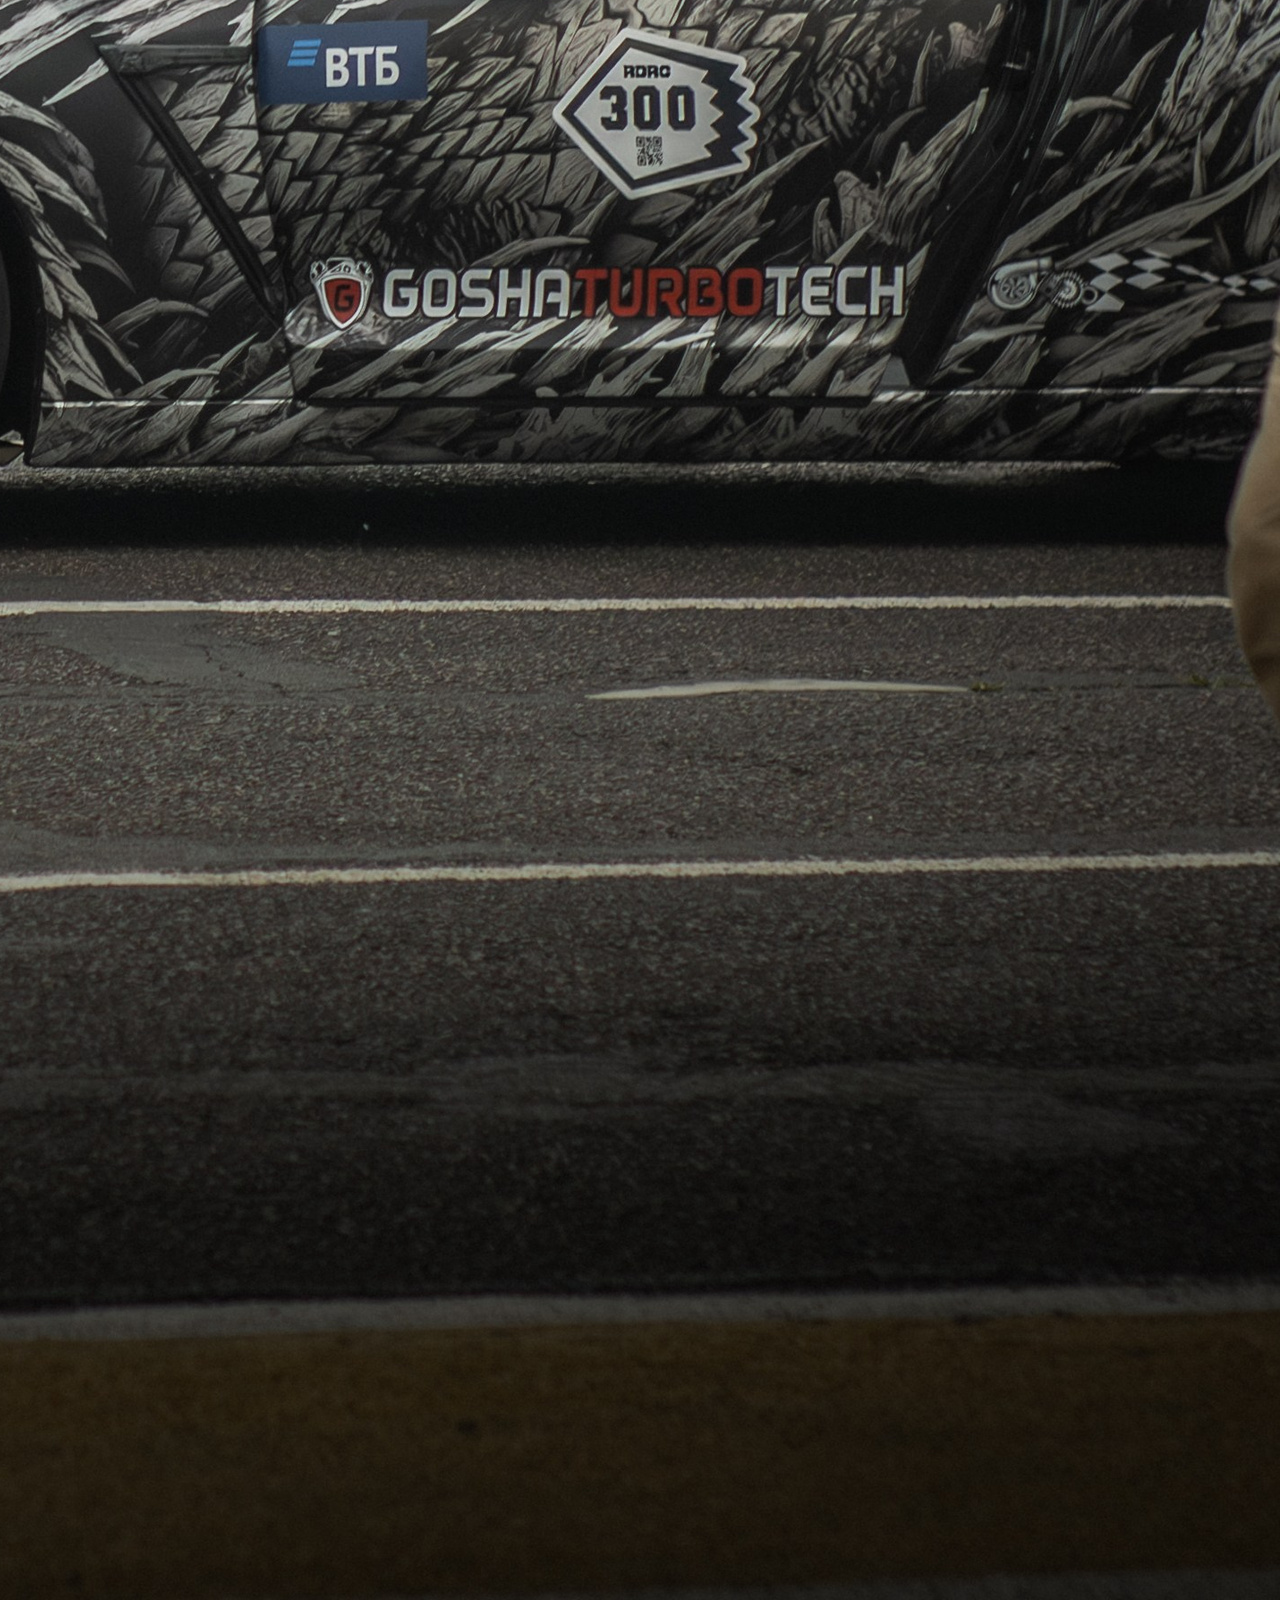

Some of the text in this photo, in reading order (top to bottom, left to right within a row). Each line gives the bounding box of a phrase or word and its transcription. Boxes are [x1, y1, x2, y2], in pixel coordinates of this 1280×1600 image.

[324, 45, 401, 88] ВТБ
[623, 64, 671, 79] RDRC
[599, 85, 697, 131] 300
